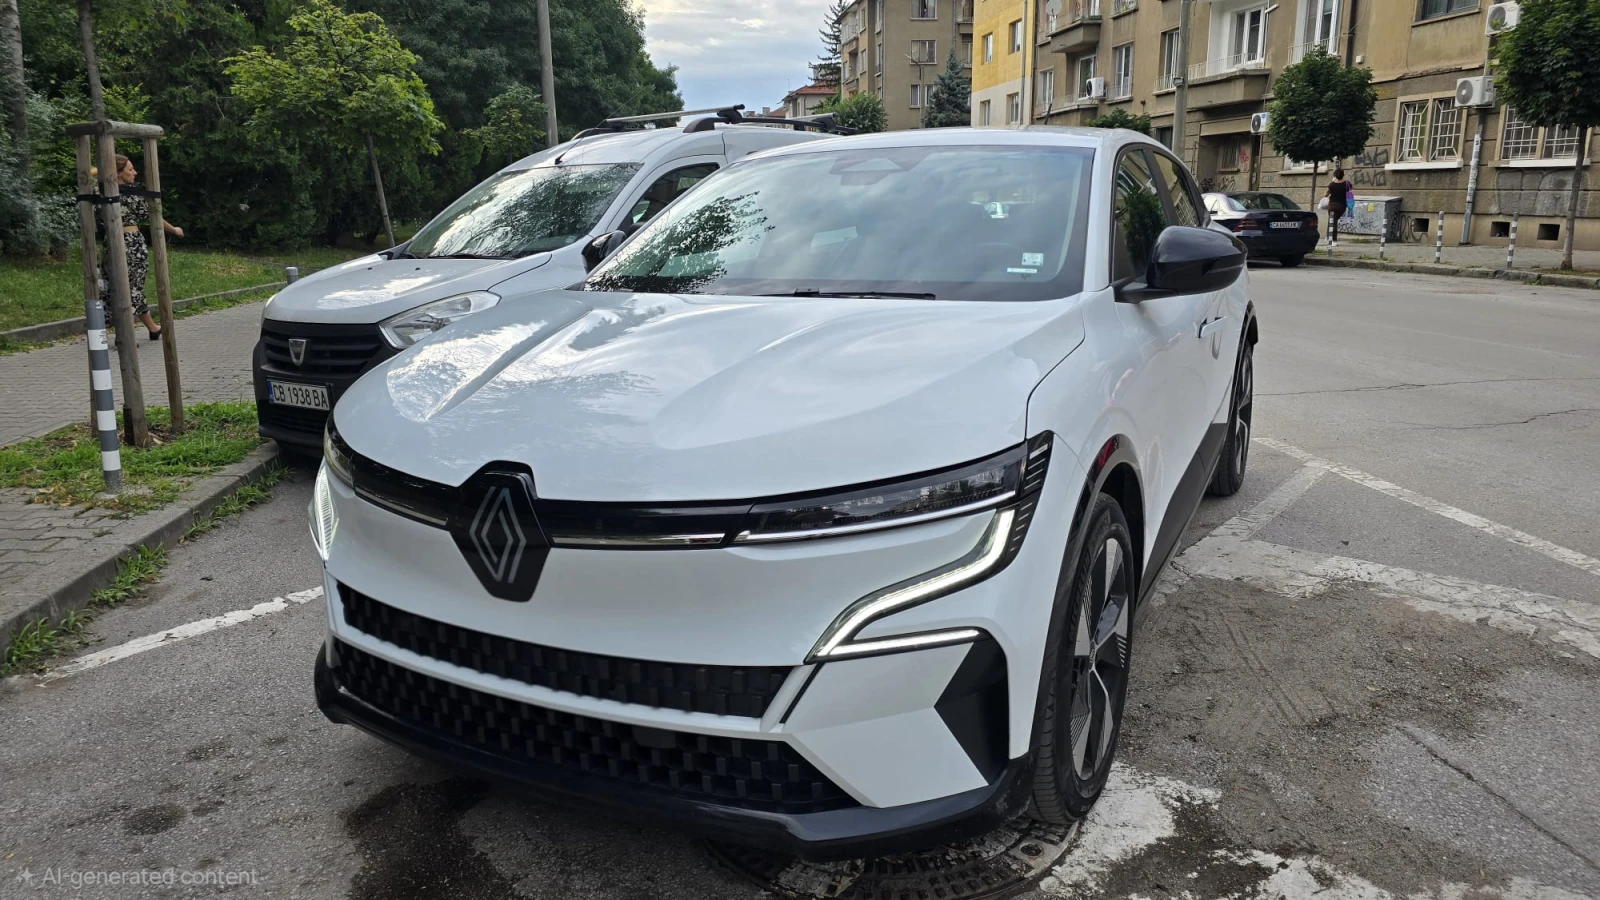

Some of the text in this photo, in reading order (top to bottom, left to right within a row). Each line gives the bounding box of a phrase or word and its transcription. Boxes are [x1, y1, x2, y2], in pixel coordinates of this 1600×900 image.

[273, 385, 328, 408] CB 1938 BA
